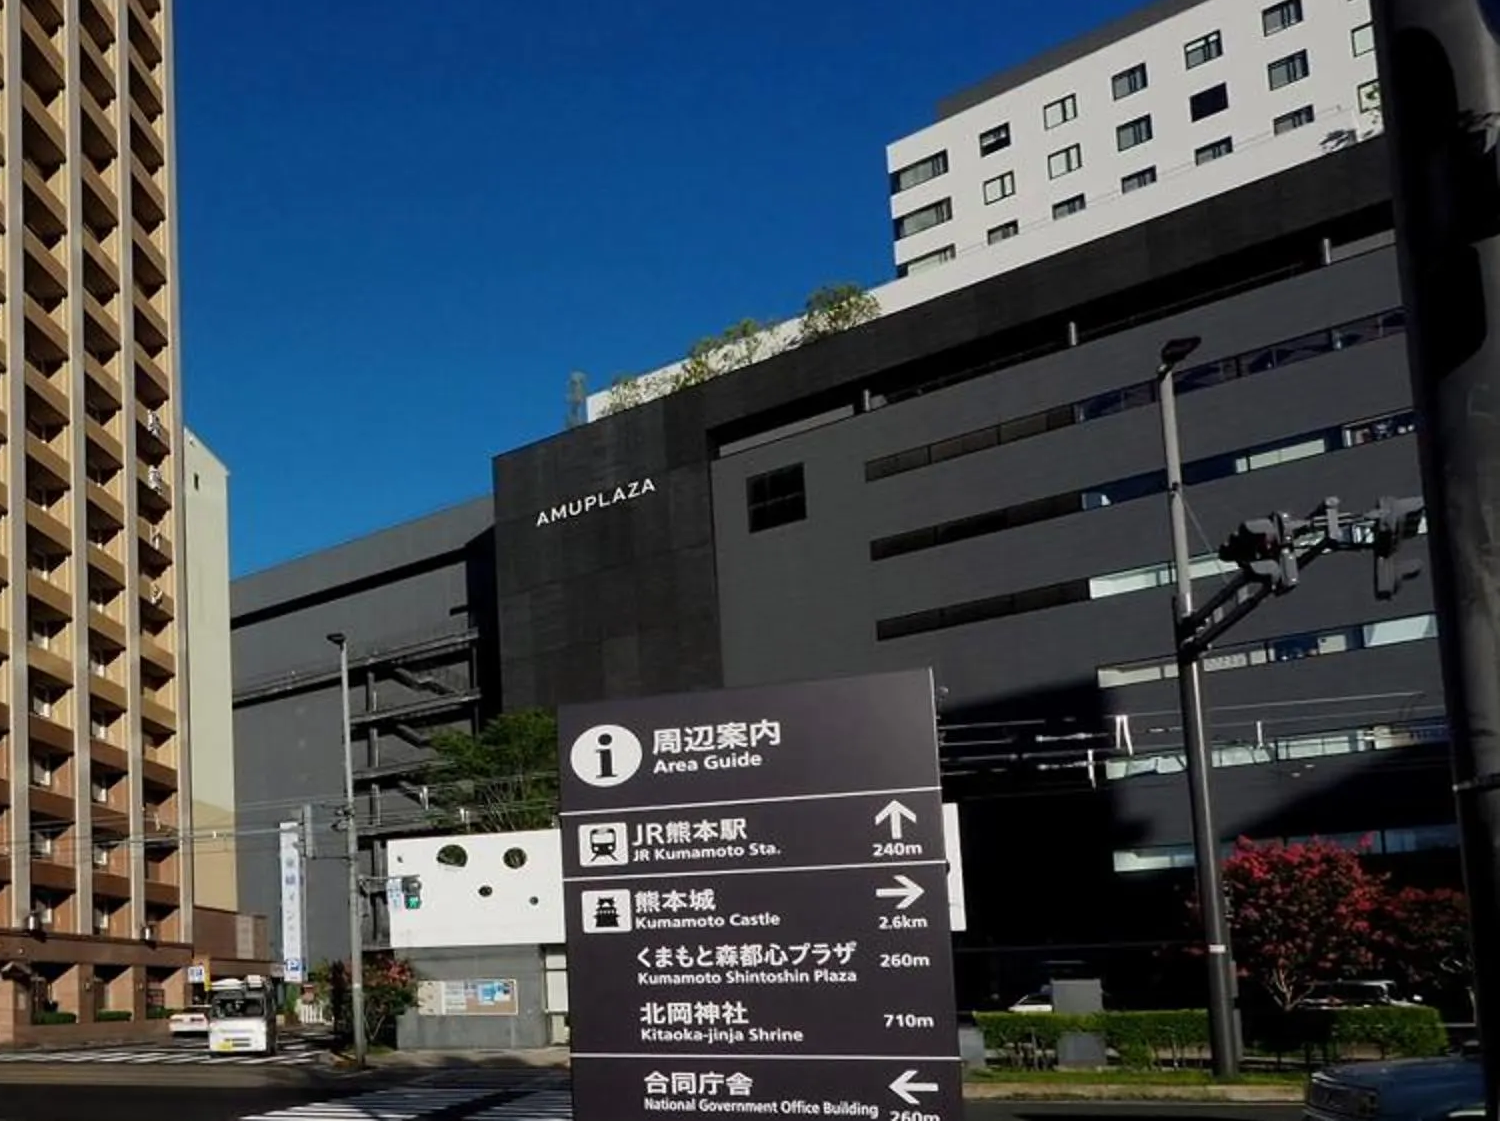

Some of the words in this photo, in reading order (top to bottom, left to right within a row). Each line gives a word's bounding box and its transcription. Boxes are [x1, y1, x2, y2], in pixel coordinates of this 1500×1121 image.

[535, 478, 656, 527] AMUPLAZA
[652, 719, 781, 755] 周辺案内
[653, 759, 698, 774] Area
[704, 752, 762, 770] Guide
[632, 818, 748, 846] JR熊本駅
[632, 849, 650, 862] JR
[654, 844, 745, 861] Kumamoto
[749, 842, 781, 856] Sta.
[872, 843, 923, 856] 240m
[634, 888, 716, 913] 熊本城
[635, 915, 725, 930] Kumamoto
[729, 912, 781, 926] Castle
[878, 915, 928, 929] 2.6km
[637, 941, 858, 968] くまもと森都心プラザ
[879, 954, 931, 968] 260m
[638, 972, 722, 985] Kumamoto
[725, 969, 809, 984] Shintoshin
[813, 968, 858, 982] Plaza
[639, 1001, 749, 1025] 北岡神社
[883, 1014, 935, 1028] 710m
[641, 1028, 745, 1043] Kitaoka-jinja
[748, 1028, 804, 1042] Shrine
[644, 1070, 754, 1096] 合同庁舎
[644, 1097, 696, 1112] National
[699, 1098, 777, 1114] Government
[780, 1100, 820, 1114] Office
[823, 1101, 879, 1119] Building
[889, 1110, 941, 1121] 260m
